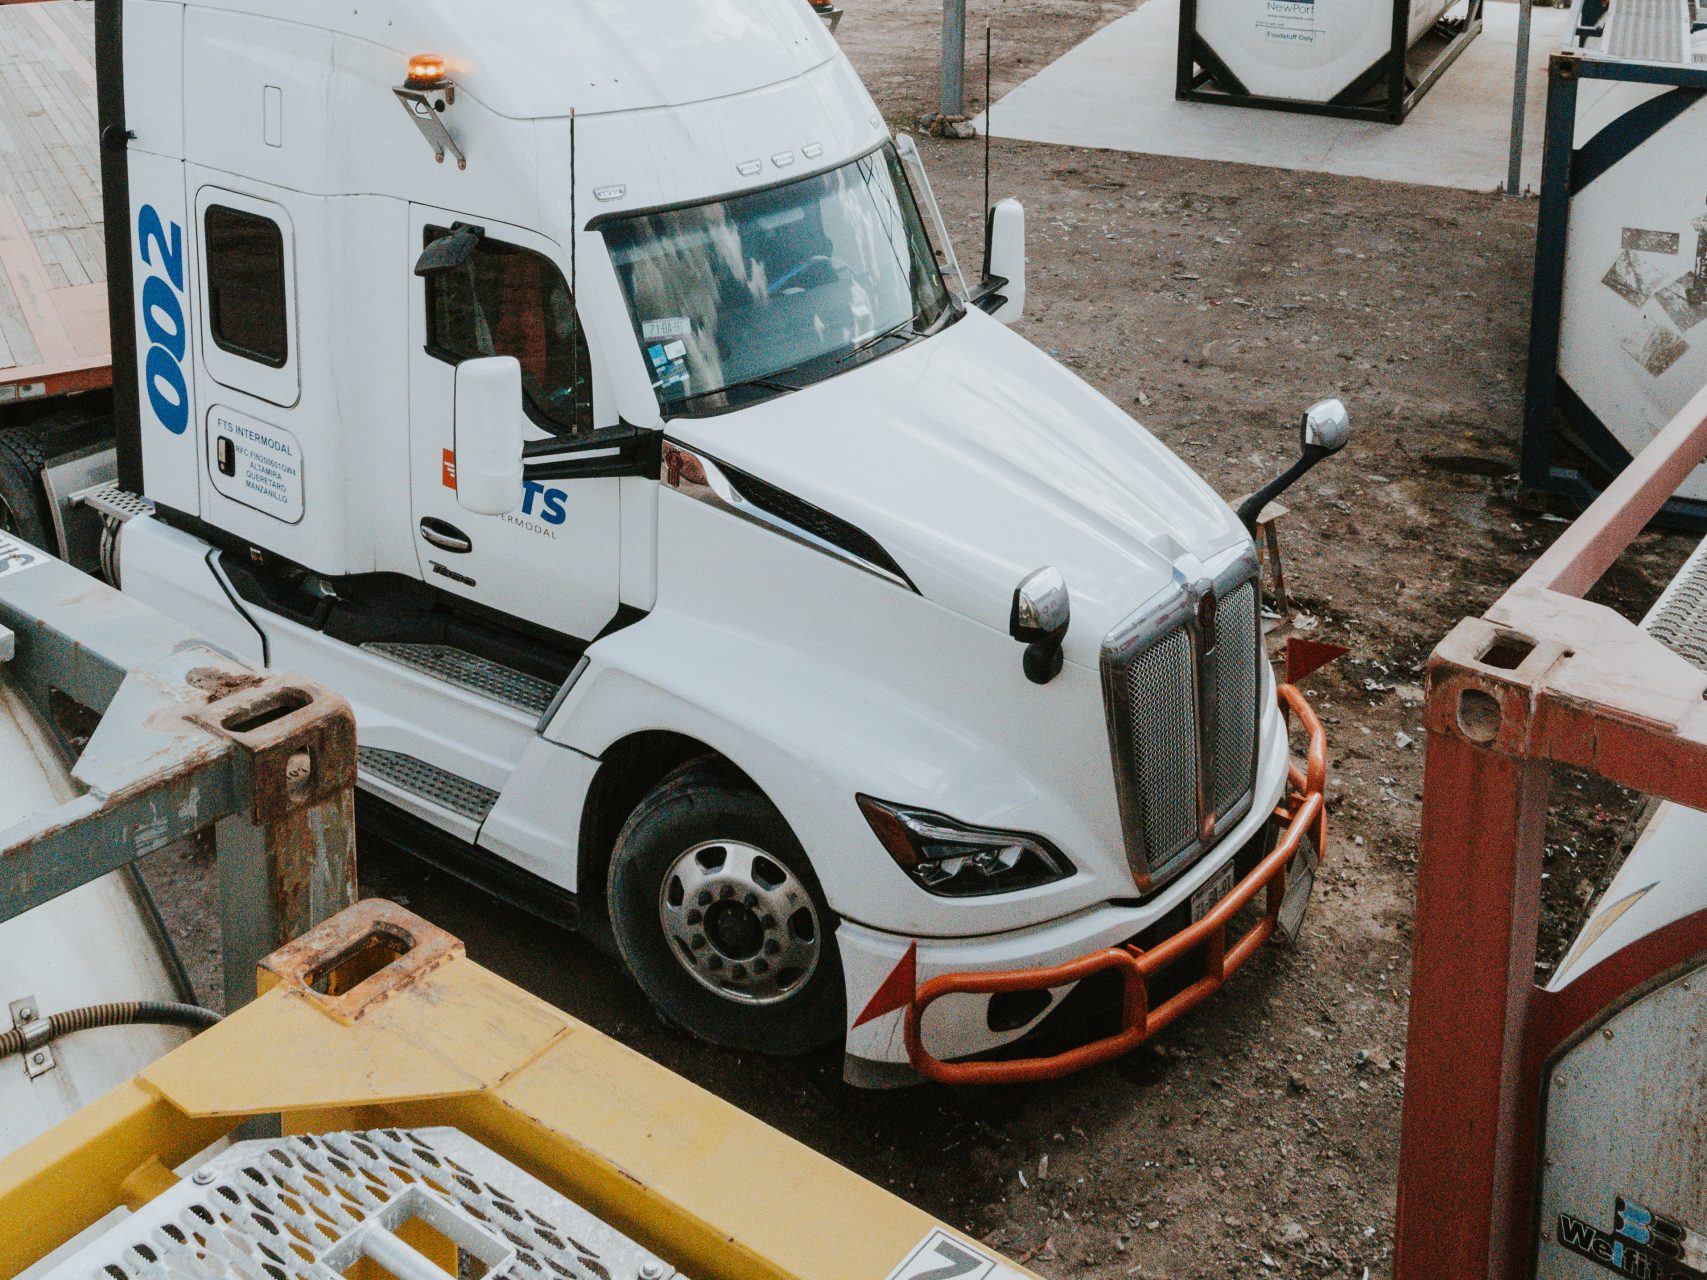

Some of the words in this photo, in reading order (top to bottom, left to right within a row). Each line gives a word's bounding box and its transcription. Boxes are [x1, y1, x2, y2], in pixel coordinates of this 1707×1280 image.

[1267, 1, 1315, 15] NewPort
[1267, 31, 1297, 40] Foodstuff
[1298, 33, 1313, 42] Only
[138, 203, 189, 435] 002
[217, 418, 234, 433] FTS
[235, 425, 293, 456] INTERMODAL
[246, 470, 287, 493] QUERETARO
[249, 461, 282, 480] ALTAMIRA
[245, 480, 288, 504] MANZANILLO
[521, 480, 568, 525] TS
[500, 513, 558, 540] ERMODAL
